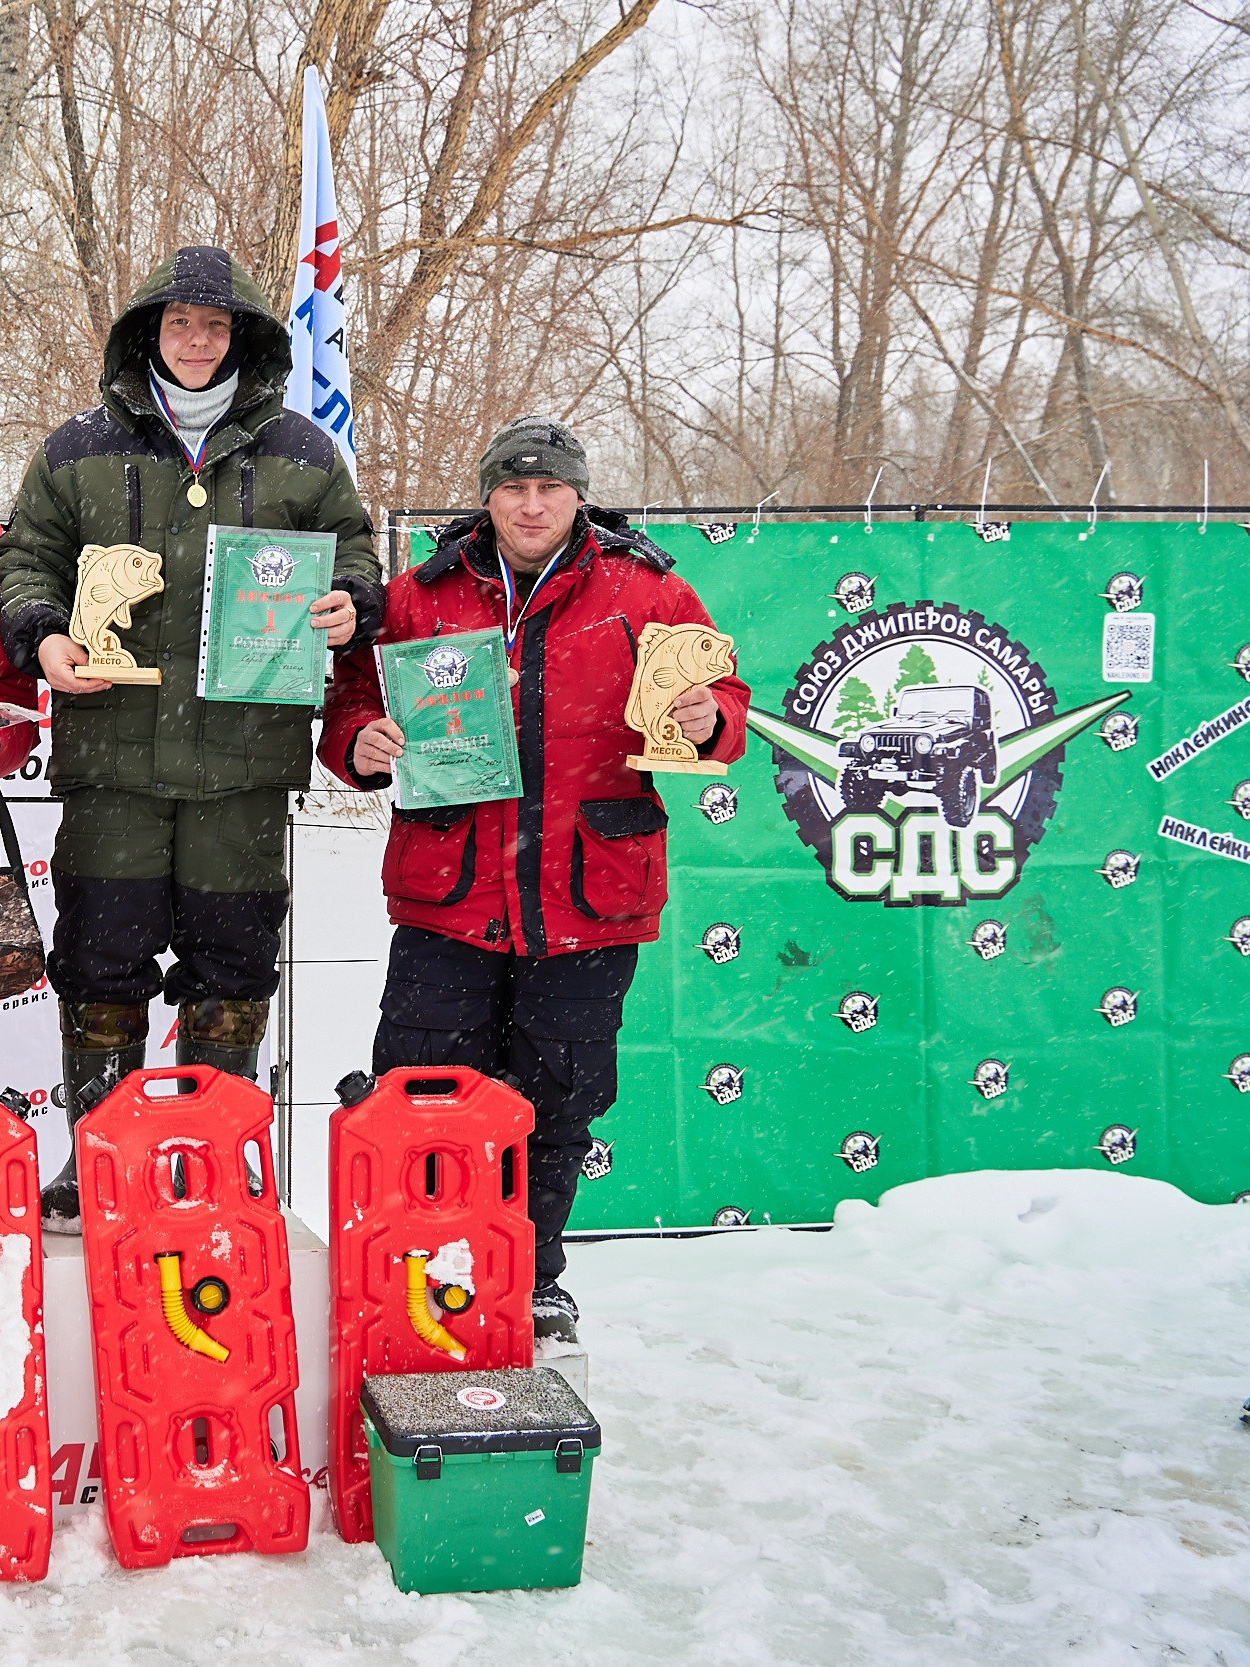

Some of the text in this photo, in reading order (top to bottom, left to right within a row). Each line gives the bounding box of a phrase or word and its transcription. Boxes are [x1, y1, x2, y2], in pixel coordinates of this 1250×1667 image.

[709, 526, 736, 544] СДС
[982, 525, 1009, 543] СДС
[234, 589, 306, 605] ДИПЛОМ
[847, 596, 874, 614] СДС
[1111, 595, 1141, 613] СДС
[260, 609, 276, 630] 1
[102, 635, 114, 652] 1
[92, 657, 122, 666] МЕСТО
[792, 611, 1049, 716] СОЮЗ ДЖИПЕРОВ САМАРЫ
[414, 688, 486, 710] ДИПЛОМ
[446, 709, 462, 729] 3
[662, 723, 676, 741] 3
[650, 746, 683, 756] МЕСТО
[1111, 734, 1137, 751] СДС
[711, 807, 736, 825] СДС
[831, 812, 1017, 900] СДС
[1111, 871, 1137, 889] СДС
[713, 946, 739, 964] СДС
[982, 943, 1006, 961] СДС
[851, 1015, 877, 1034] СДС
[1110, 1010, 1136, 1028] СДС
[716, 1086, 742, 1105] СДС
[984, 1082, 1007, 1100] СДС
[852, 1154, 879, 1173] СДС
[1110, 1148, 1135, 1165] СДС
[585, 1161, 612, 1181] СДС
